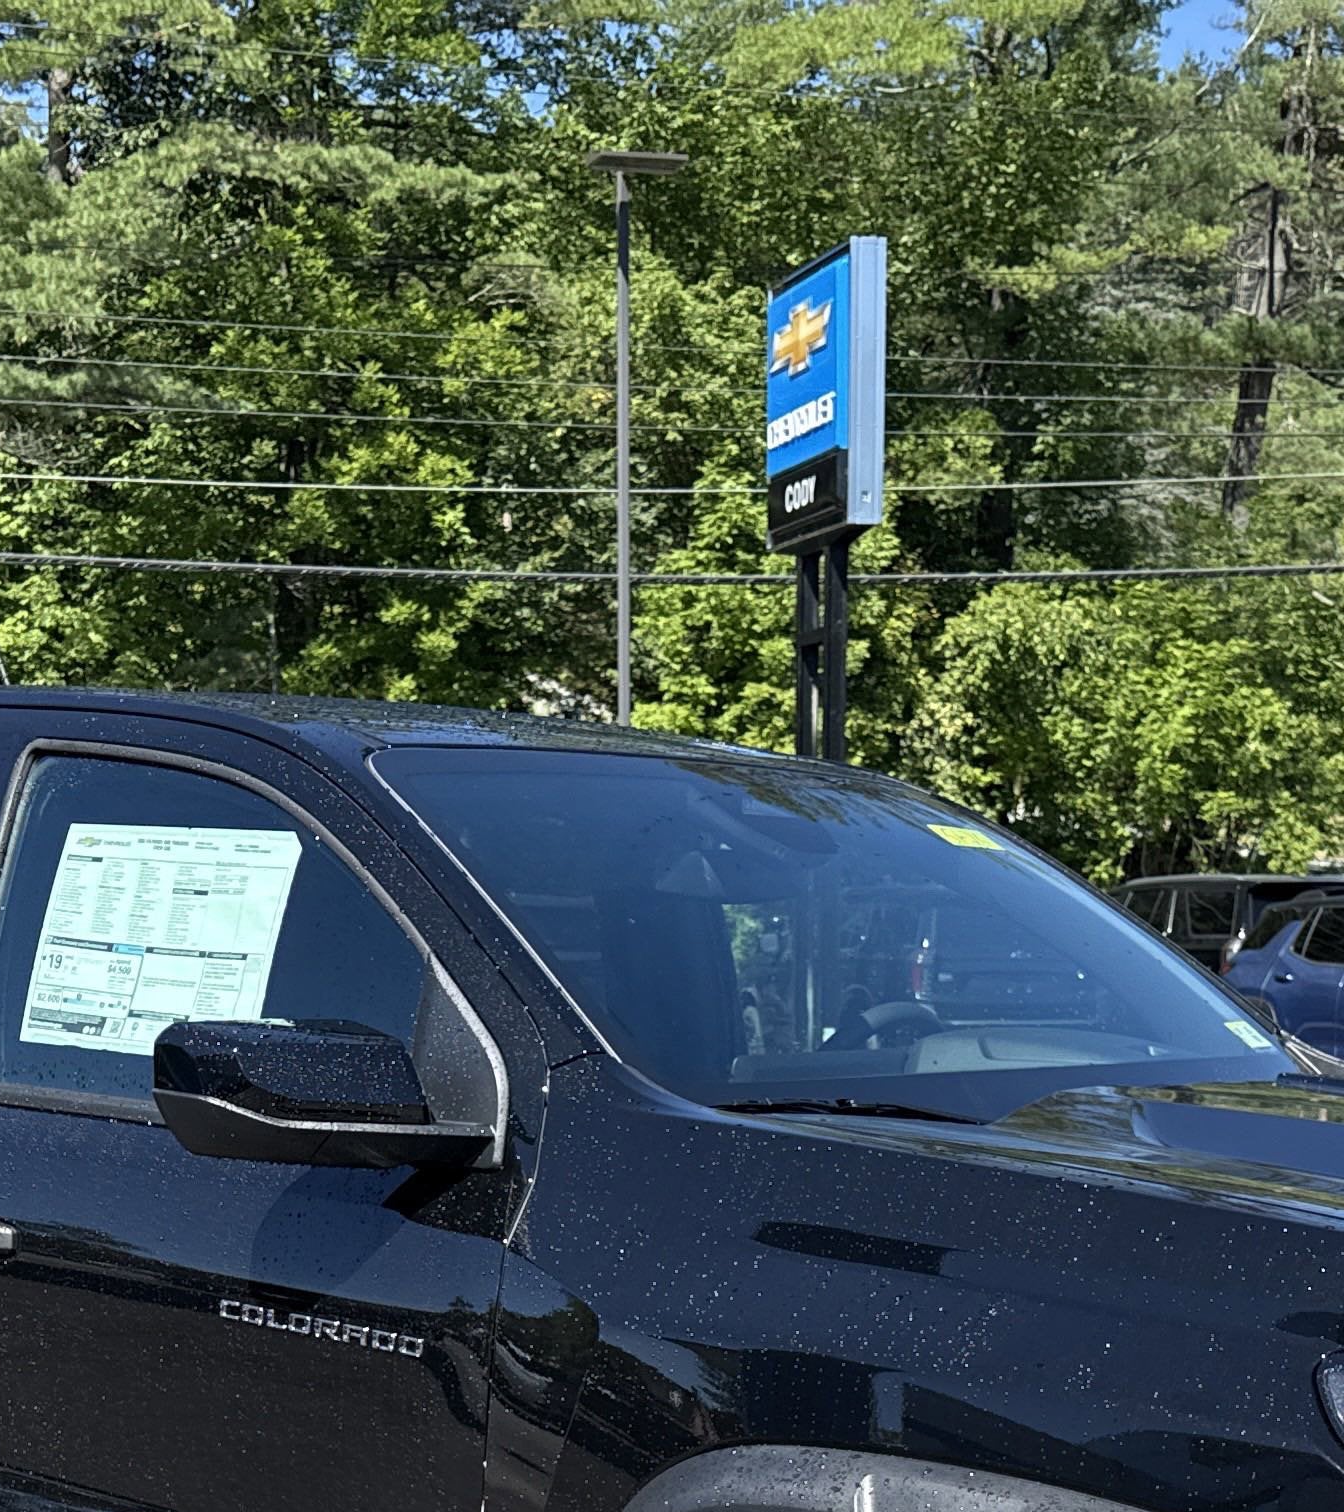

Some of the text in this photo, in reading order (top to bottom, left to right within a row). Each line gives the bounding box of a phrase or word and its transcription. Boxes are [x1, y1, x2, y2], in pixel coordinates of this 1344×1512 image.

[784, 475, 817, 513] CODY
[49, 954, 63, 969] 19
[220, 1299, 424, 1358] COLORADO
